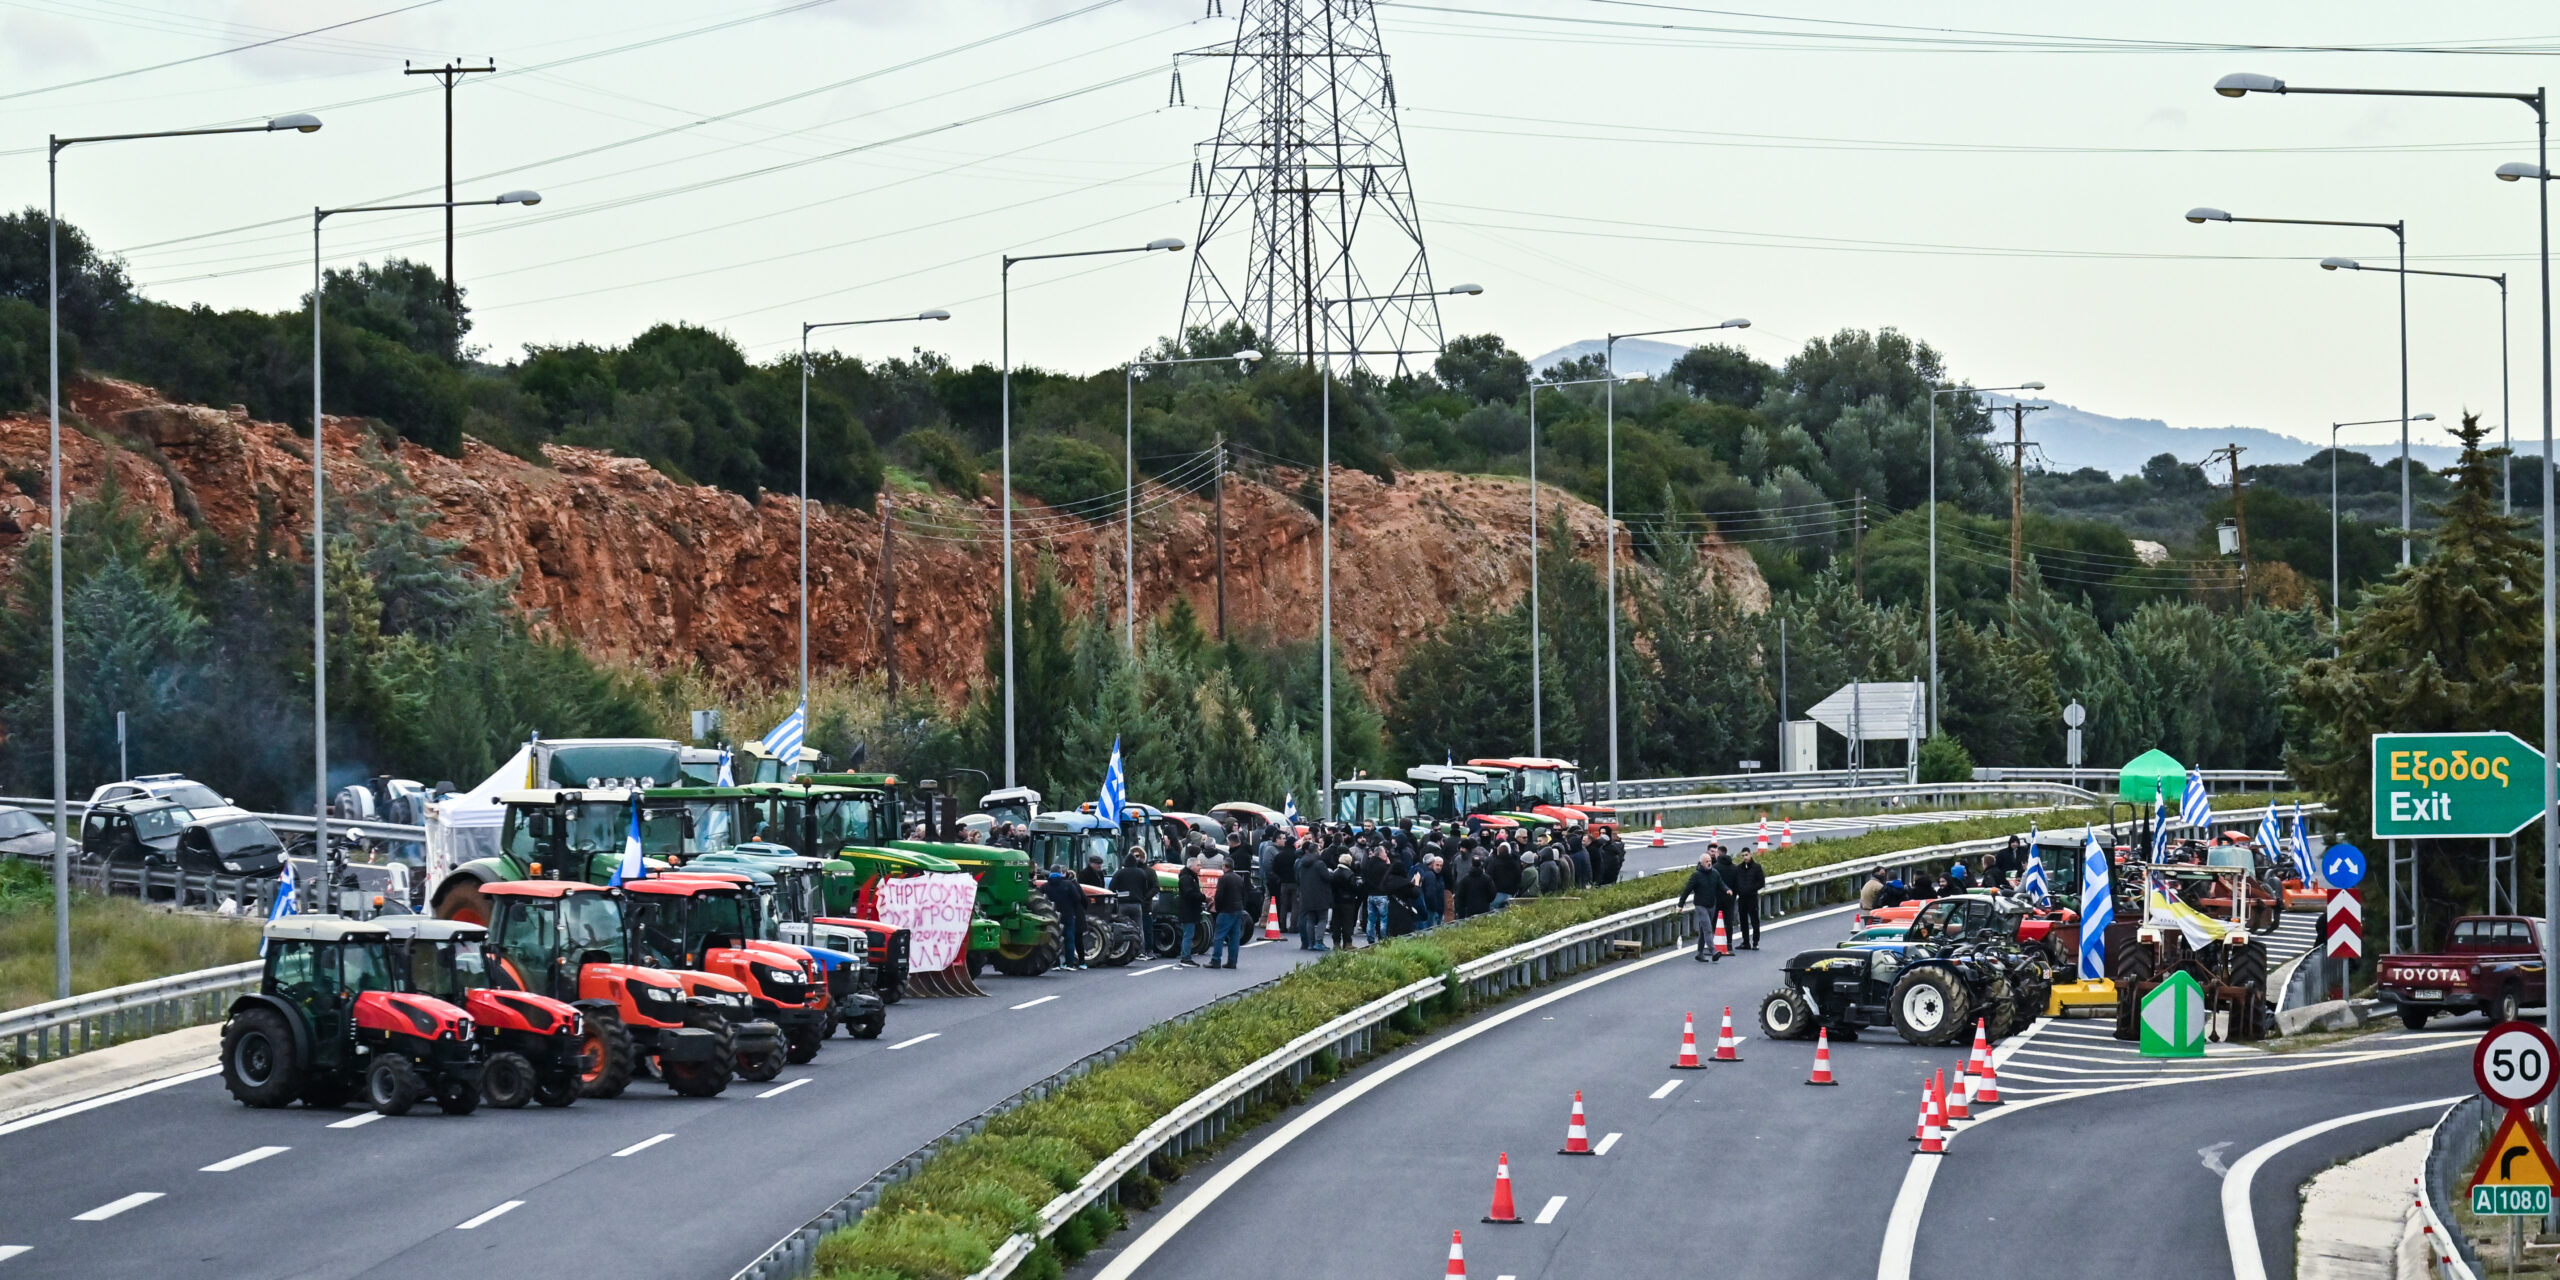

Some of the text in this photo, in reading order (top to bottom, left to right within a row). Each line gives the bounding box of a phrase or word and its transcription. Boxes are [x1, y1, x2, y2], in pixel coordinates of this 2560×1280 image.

[2390, 750, 2510, 789] Εξοδος
[2390, 791, 2452, 821] Exit
[2393, 968, 2461, 981] TOYOTA
[2493, 1049, 2541, 1081] 50
